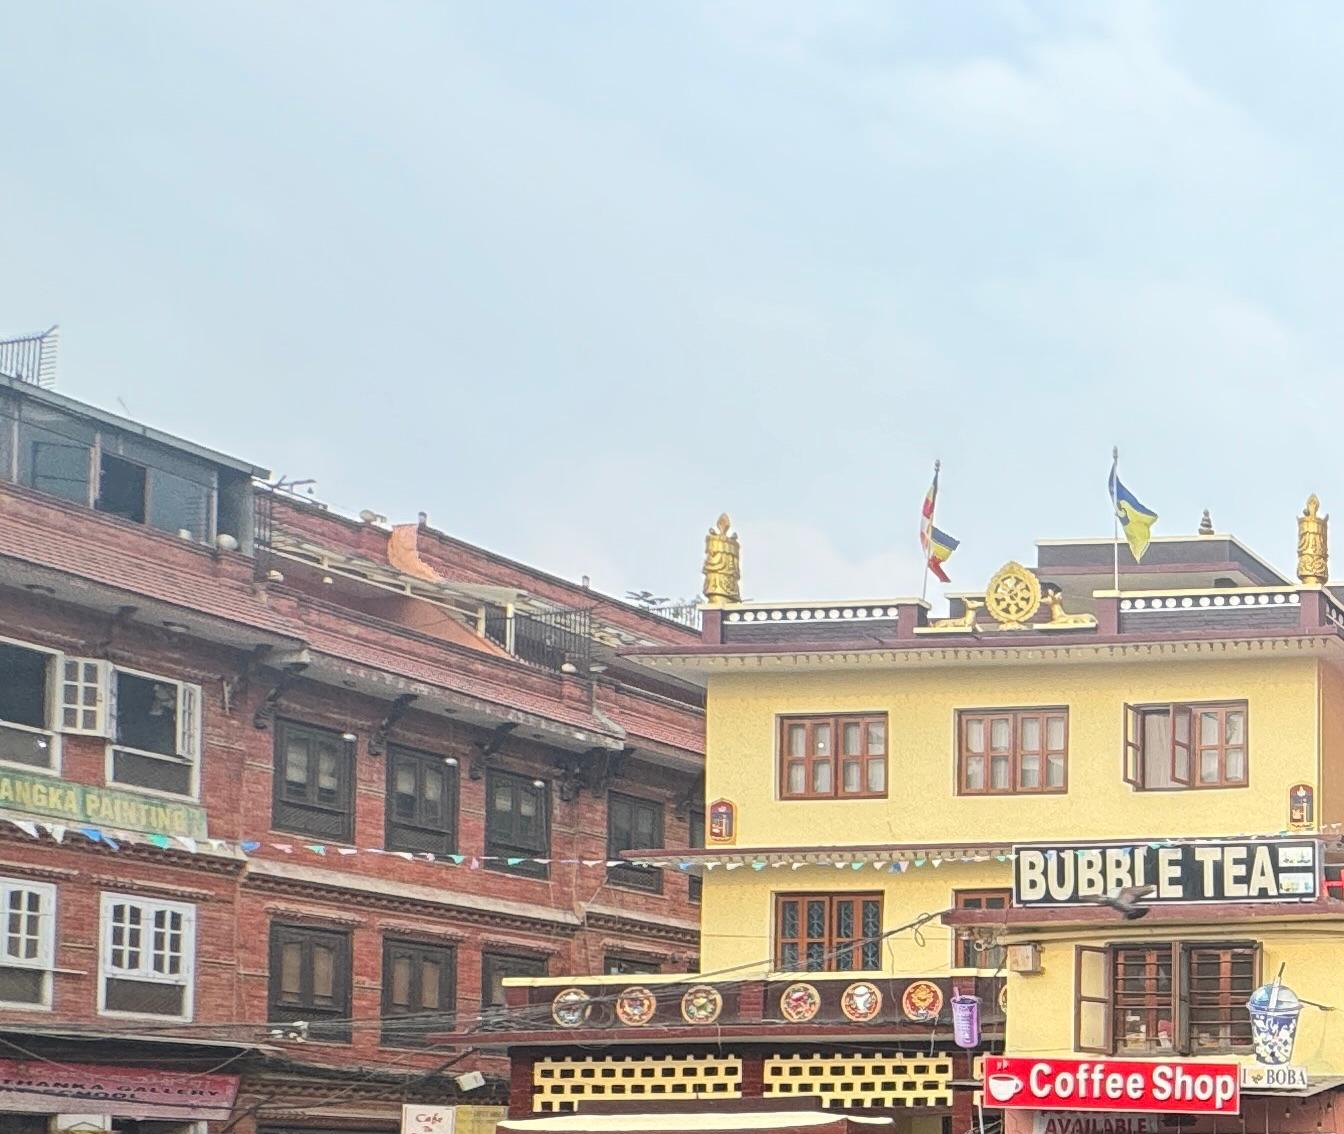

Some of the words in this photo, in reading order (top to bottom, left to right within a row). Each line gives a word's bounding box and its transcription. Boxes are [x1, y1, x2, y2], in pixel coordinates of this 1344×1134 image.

[1020, 848, 1182, 901] BUBBLE
[1195, 846, 1278, 898] TEA
[3, 1079, 104, 1091] THANKA
[117, 1086, 219, 1096] GALLERY
[1029, 1062, 1145, 1101] Coffee
[1151, 1065, 1235, 1109] Shop
[1242, 1068, 1248, 1085] I
[1267, 1068, 1306, 1086] BOBA
